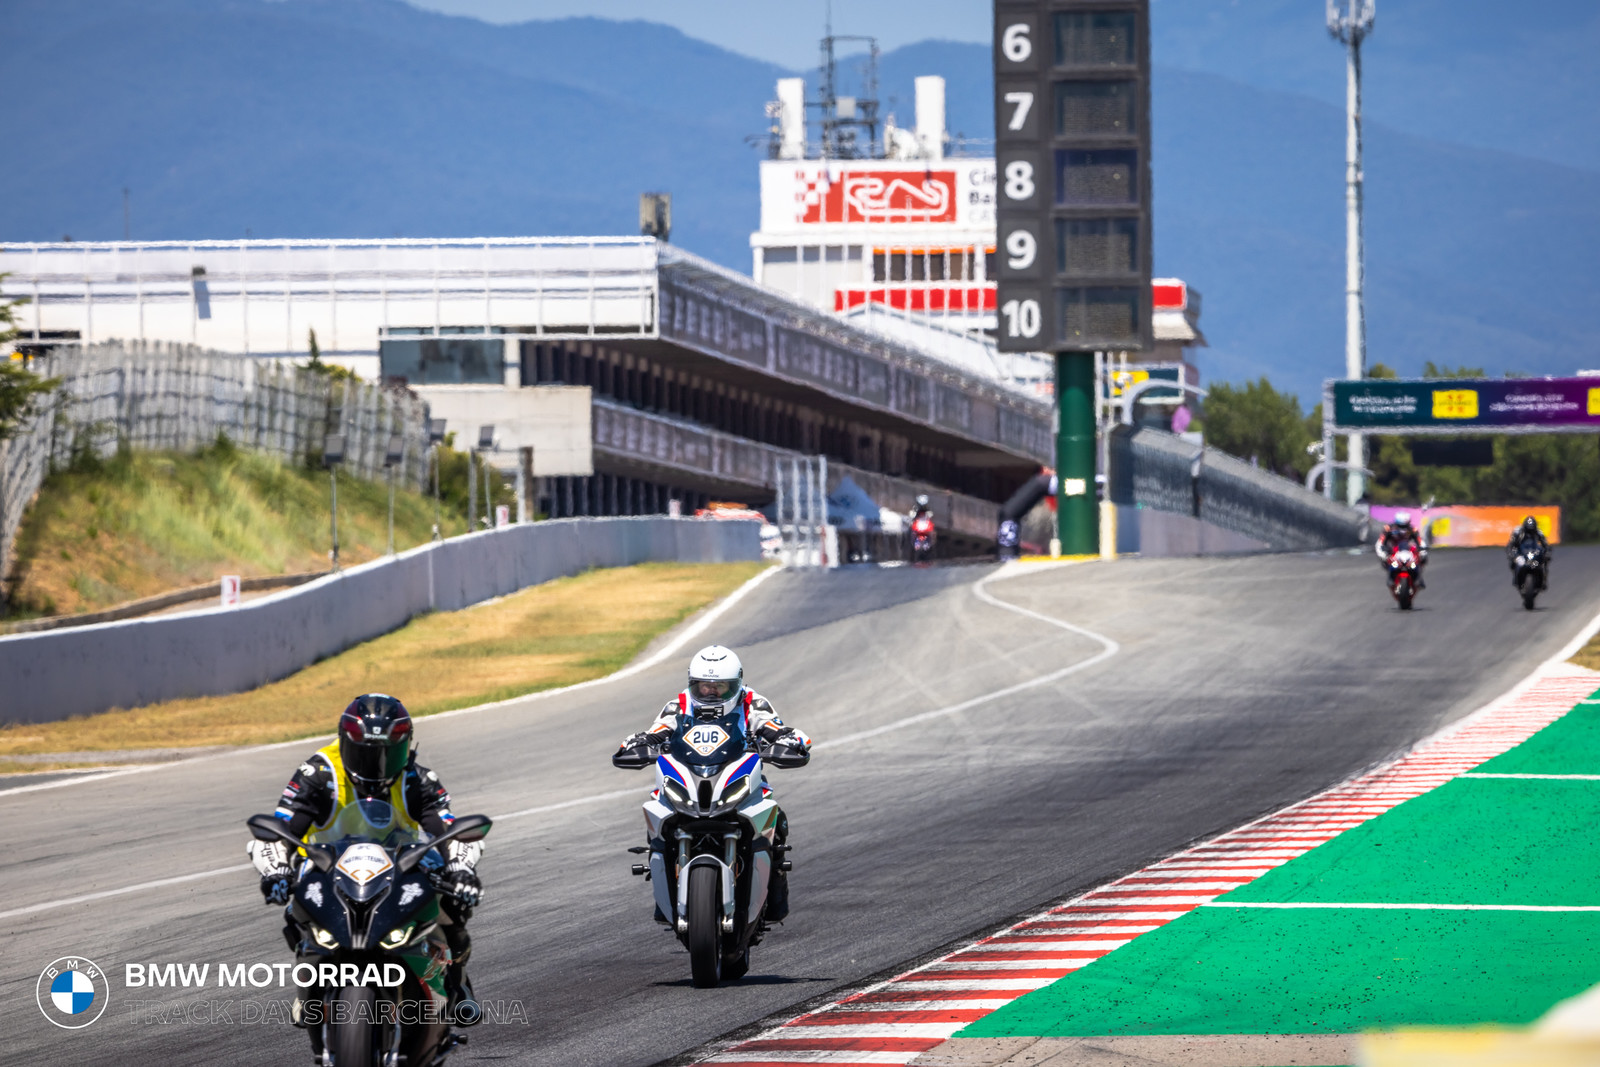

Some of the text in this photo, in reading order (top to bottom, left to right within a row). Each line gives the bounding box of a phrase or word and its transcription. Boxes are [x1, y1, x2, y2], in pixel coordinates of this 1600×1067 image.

[1002, 23, 1032, 62] 6
[1004, 92, 1034, 131] 7
[1004, 160, 1035, 200] 8
[1006, 230, 1037, 270] 9
[1001, 299, 1041, 338] 10
